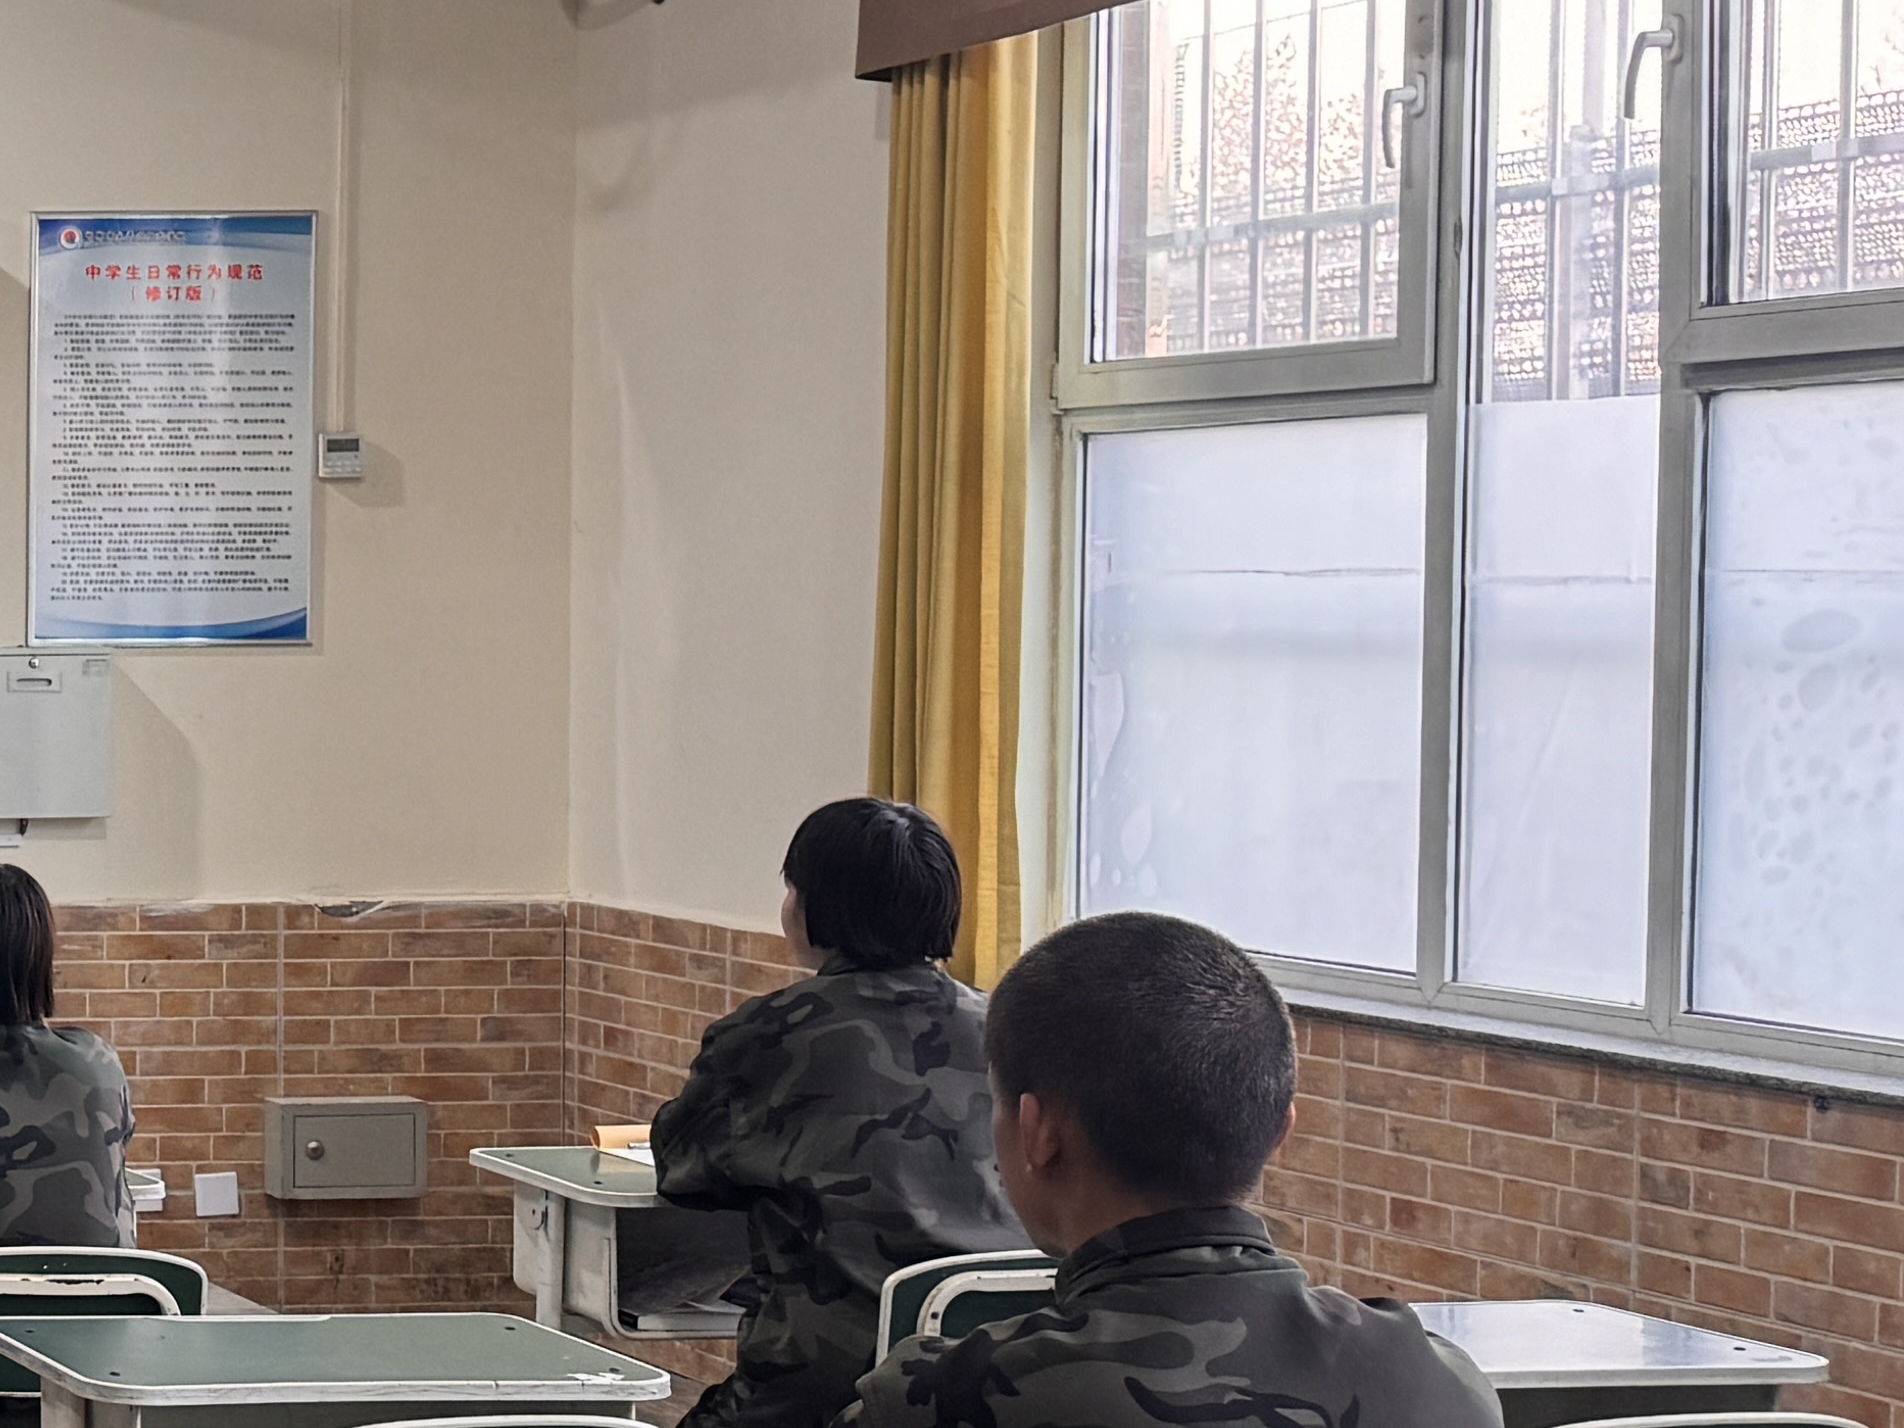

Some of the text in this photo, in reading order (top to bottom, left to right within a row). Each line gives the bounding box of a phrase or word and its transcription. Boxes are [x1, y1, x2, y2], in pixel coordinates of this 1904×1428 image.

[85, 264, 263, 281] 中学生日常行为规范
